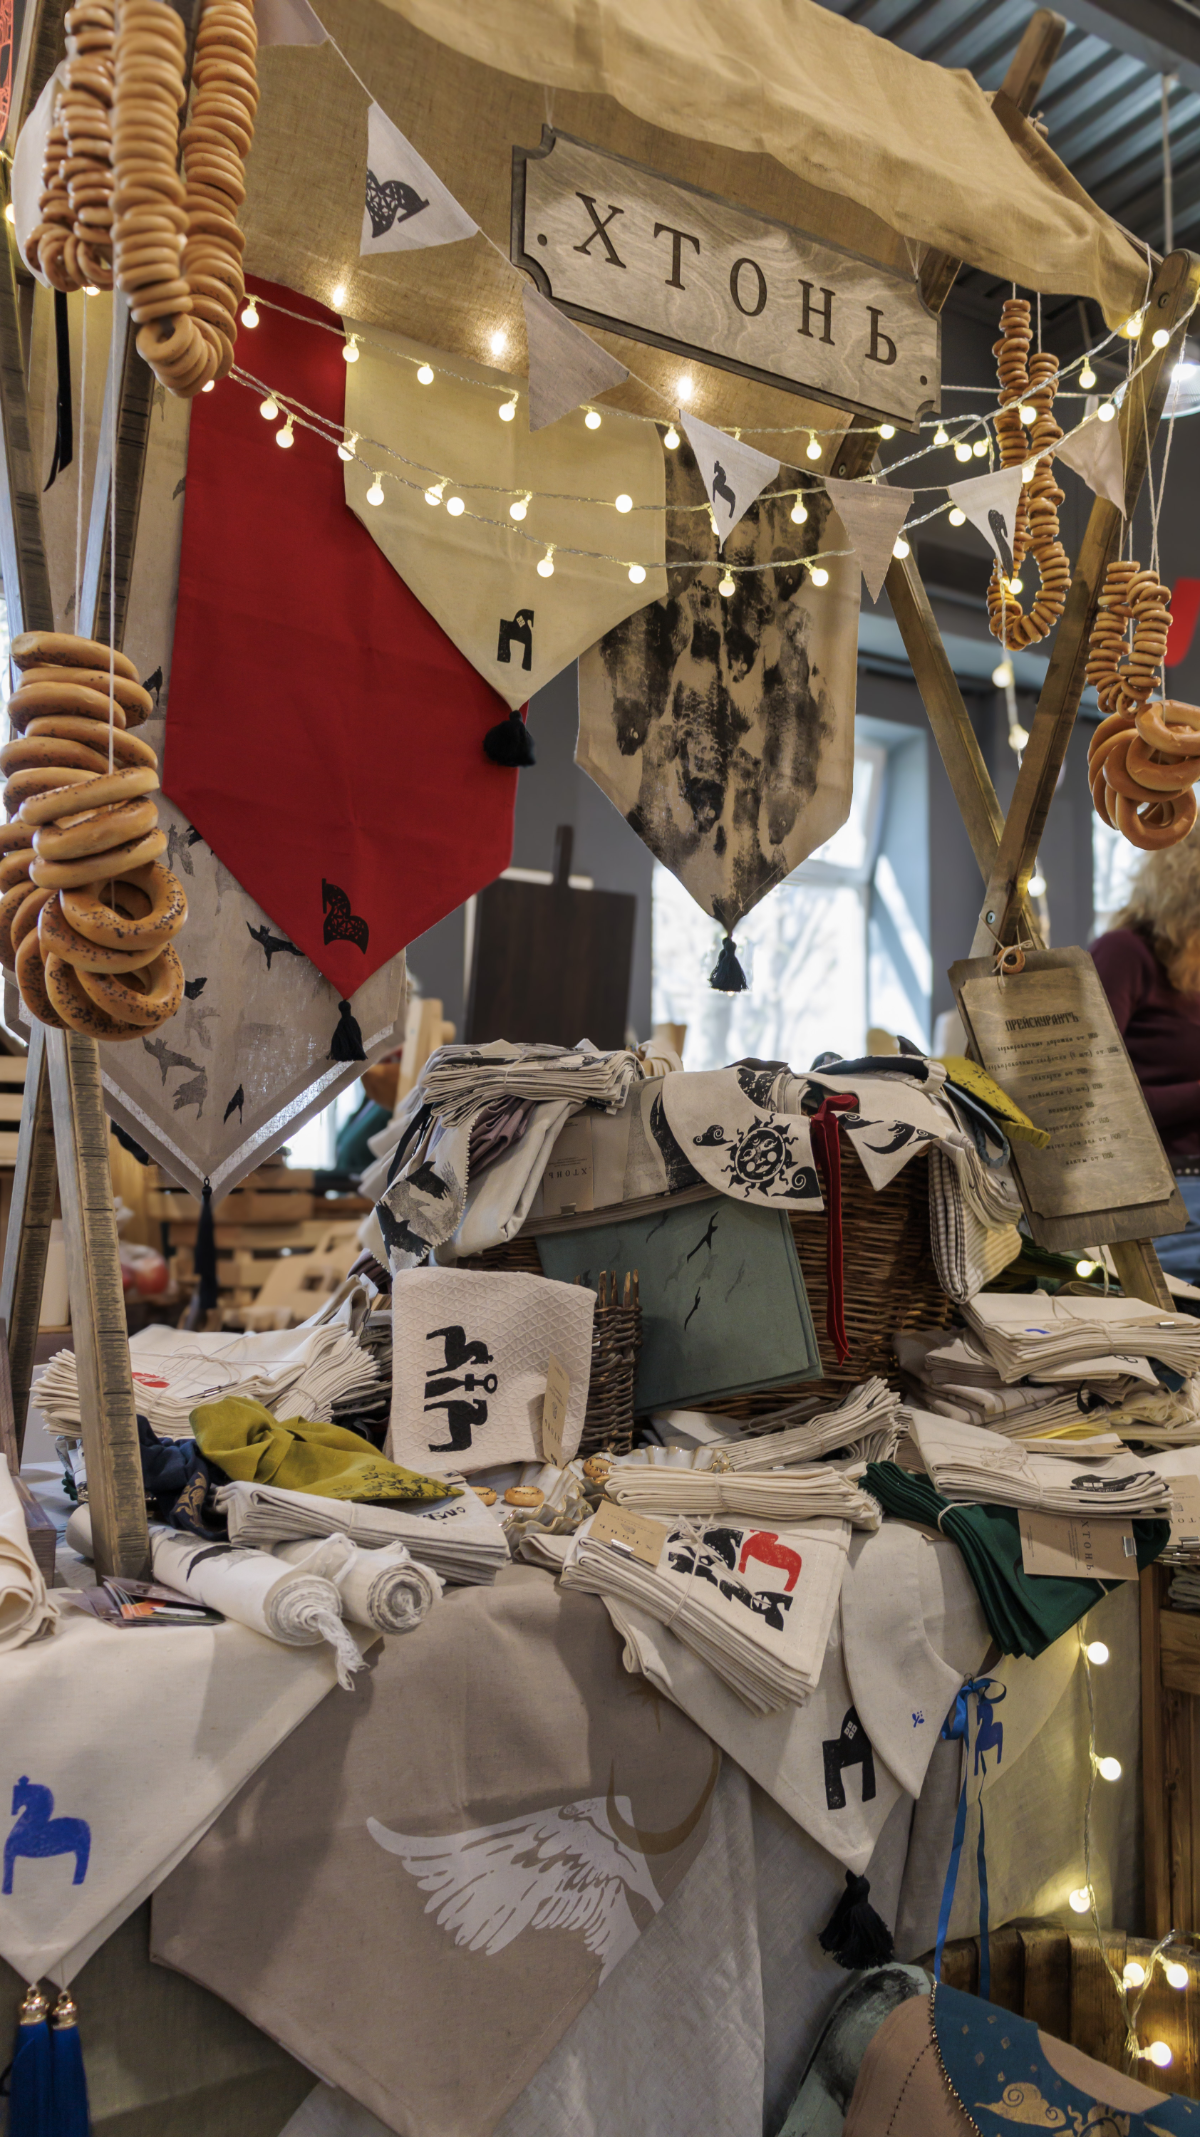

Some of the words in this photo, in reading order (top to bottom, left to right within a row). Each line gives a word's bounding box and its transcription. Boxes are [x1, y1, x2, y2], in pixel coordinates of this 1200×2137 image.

[573, 191, 897, 366] ХТОНЬ
[1005, 1012, 1079, 1032] ПРЕЙСКУРАНТЪ
[1081, 1519, 1094, 1571] ХТОНЬ
